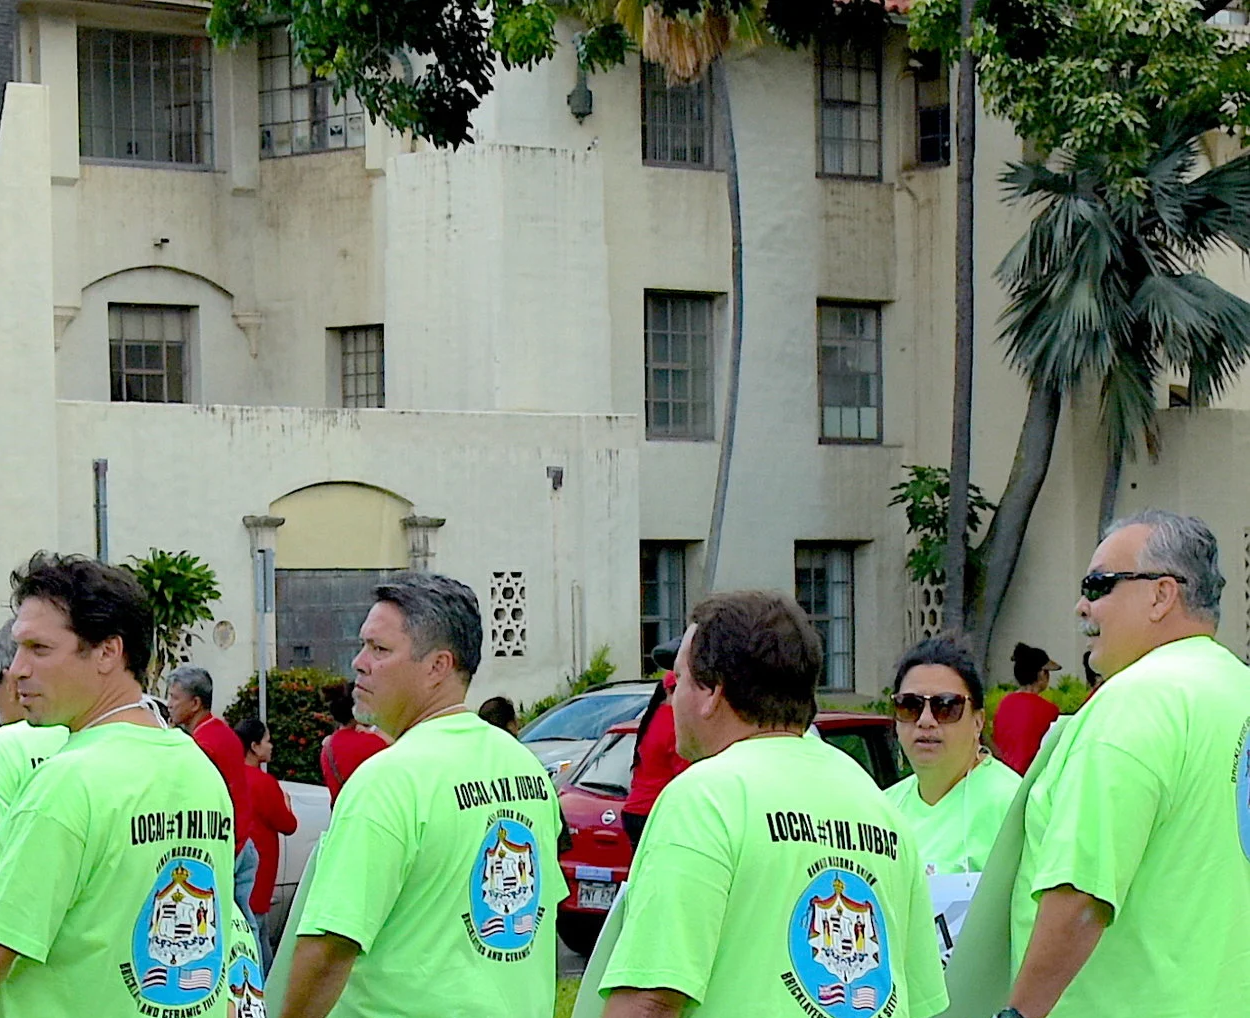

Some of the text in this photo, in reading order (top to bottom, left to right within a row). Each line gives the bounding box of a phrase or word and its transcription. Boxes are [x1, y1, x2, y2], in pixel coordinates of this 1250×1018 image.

[454, 781, 491, 811] LOCAL
[166, 810, 183, 840] #1
[187, 810, 206, 839] HI.
[766, 811, 898, 861] LOCAL #1 HI. IUBAC
[139, 1003, 159, 1018] AND
